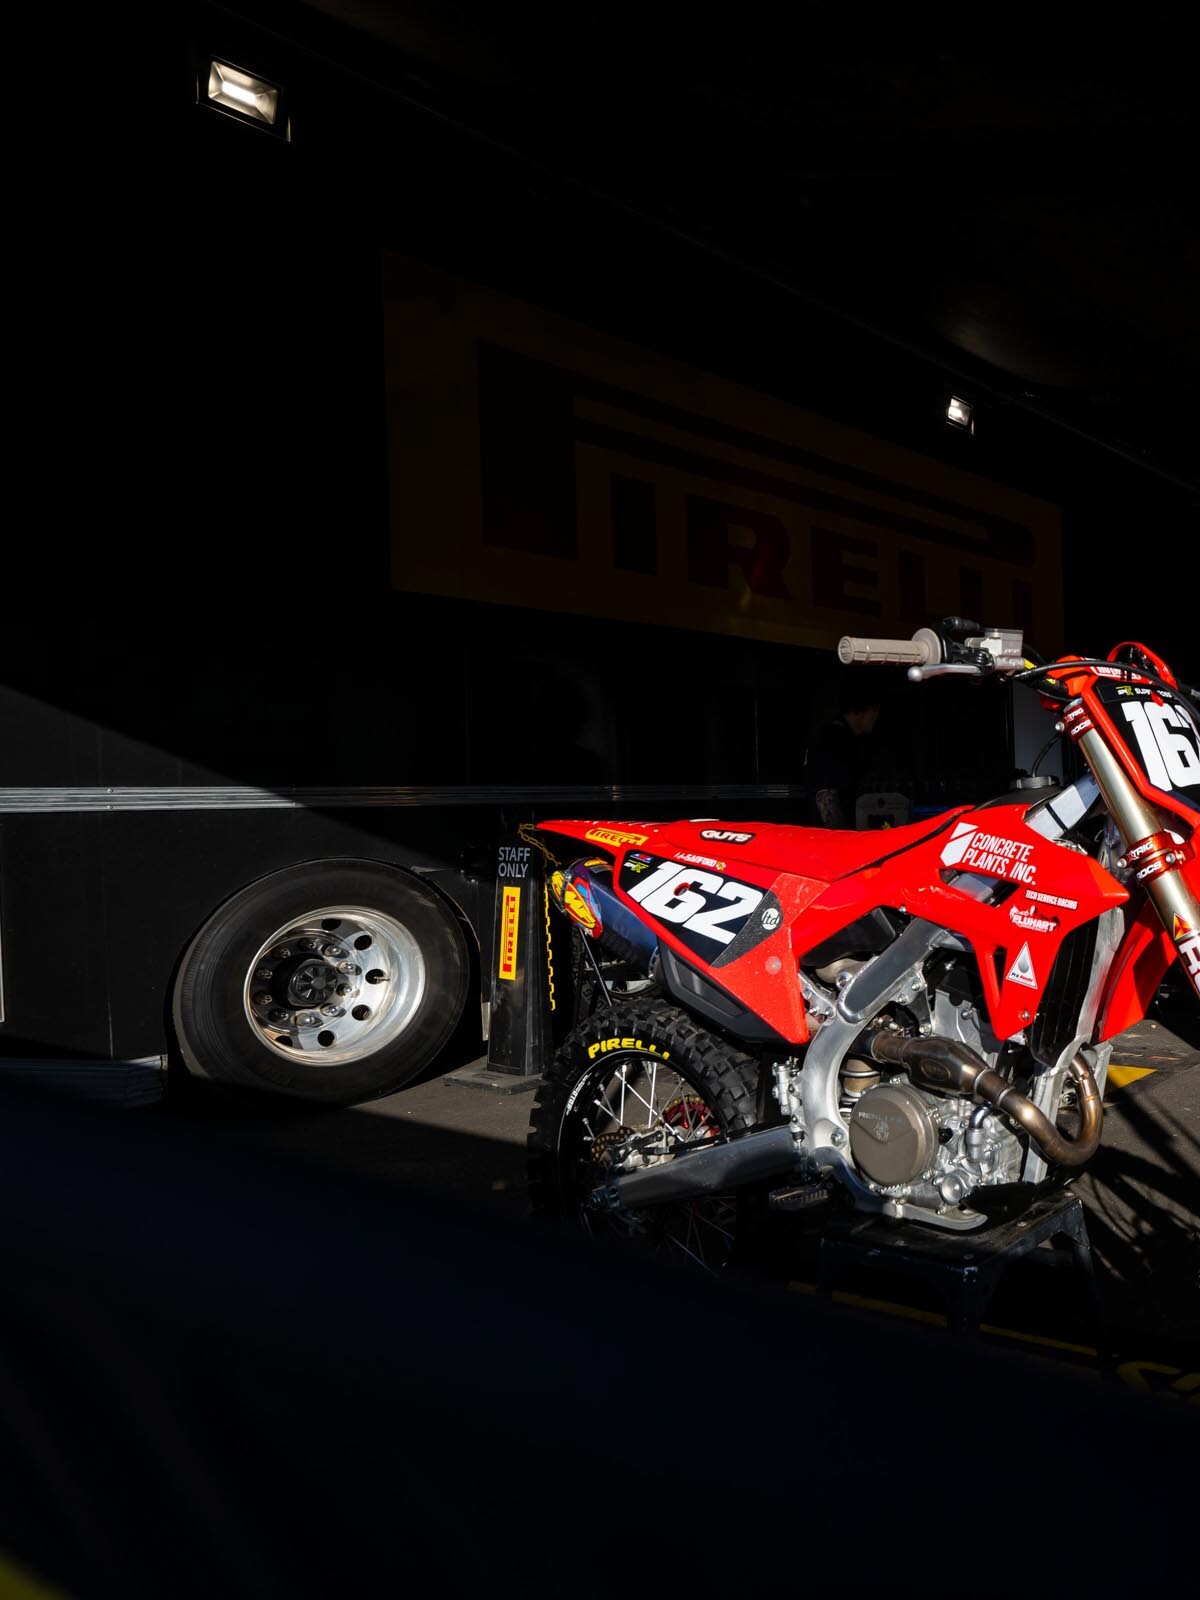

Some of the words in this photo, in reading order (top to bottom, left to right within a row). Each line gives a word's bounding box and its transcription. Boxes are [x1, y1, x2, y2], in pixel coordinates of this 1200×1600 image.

[701, 829, 751, 843] GUTS
[971, 832, 1034, 863] CONCRETE
[498, 846, 531, 863] STAFF
[498, 862, 529, 878] ONLY
[962, 848, 1007, 878] PLANTS,
[1009, 861, 1037, 886] INC.
[627, 861, 764, 945] 162
[1025, 889, 1038, 900] TECH
[1037, 892, 1059, 905] SERVICE
[1057, 897, 1078, 910] RACING
[502, 894, 516, 973] PIRELLI
[588, 1037, 671, 1060] PIRELLI
